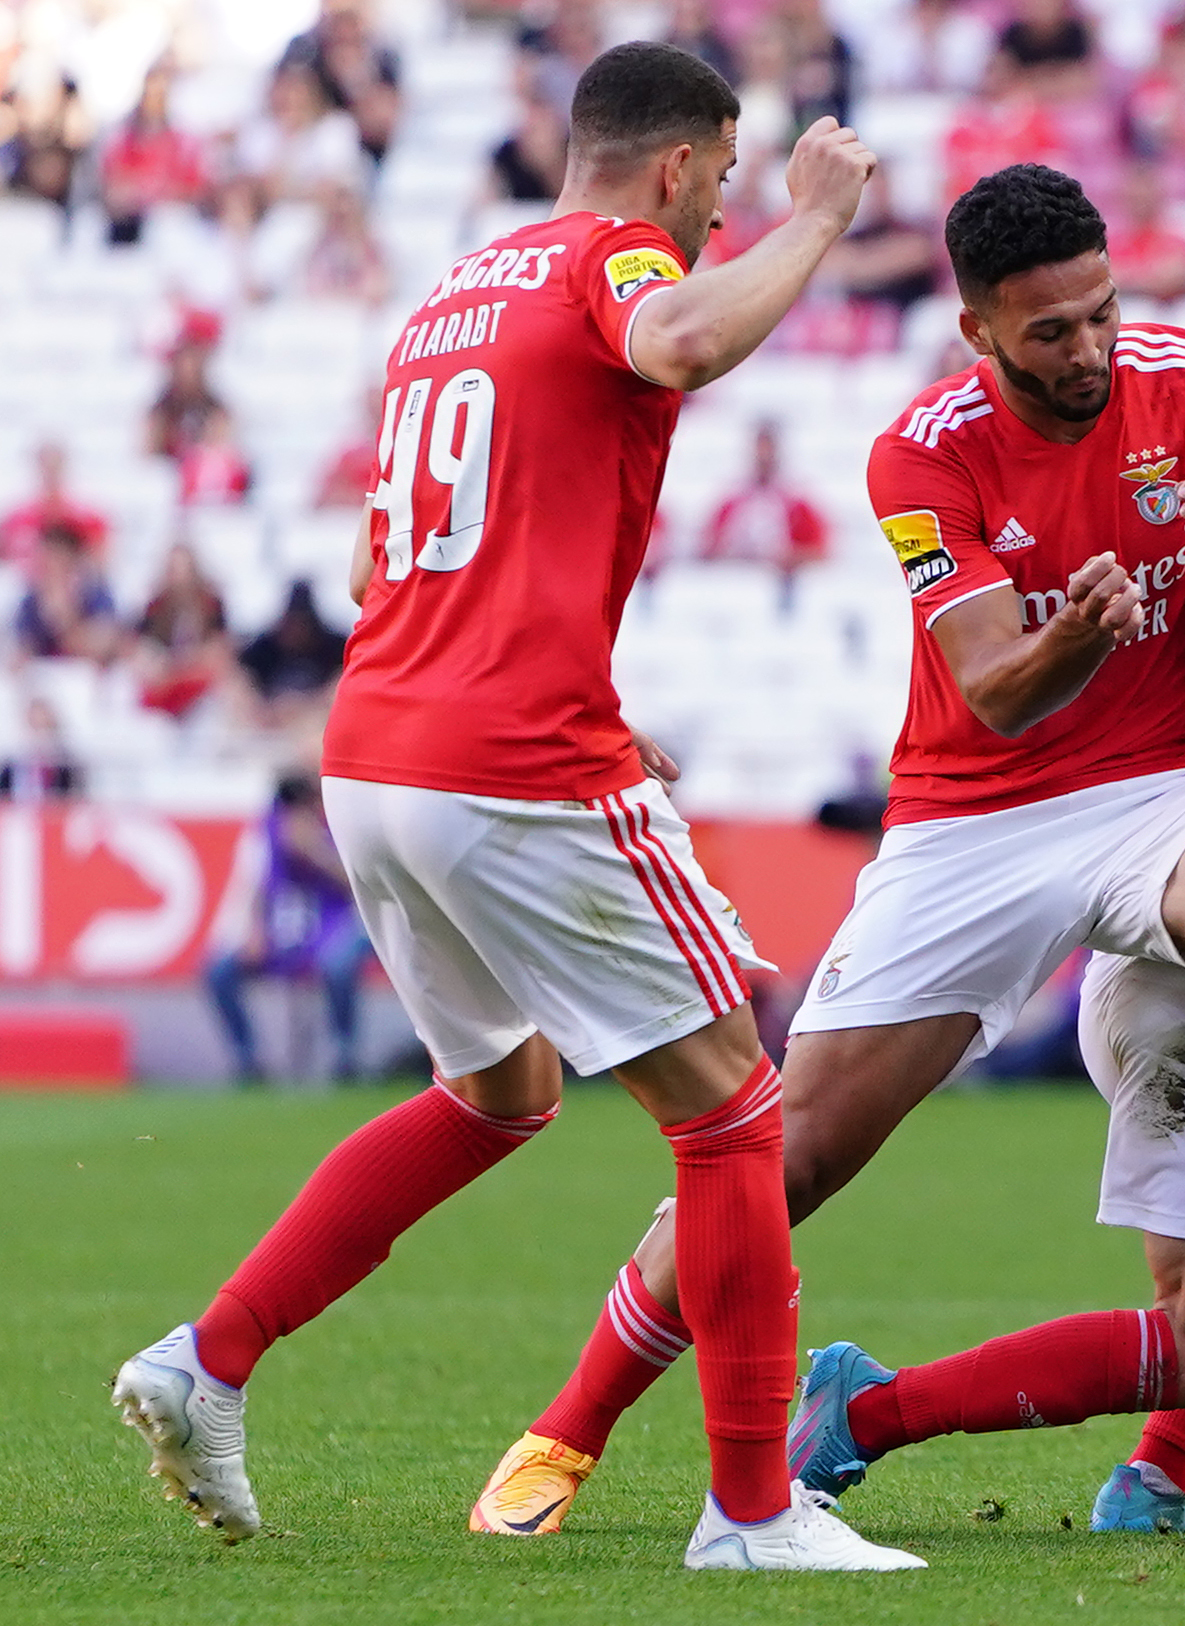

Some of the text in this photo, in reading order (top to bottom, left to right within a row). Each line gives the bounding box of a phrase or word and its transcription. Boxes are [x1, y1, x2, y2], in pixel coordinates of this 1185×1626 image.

[427, 244, 566, 307] SAGRES
[615, 256, 640, 269] LIGA
[398, 301, 507, 366] TAARABT
[372, 368, 496, 581] 49
[990, 535, 1036, 552] adidas
